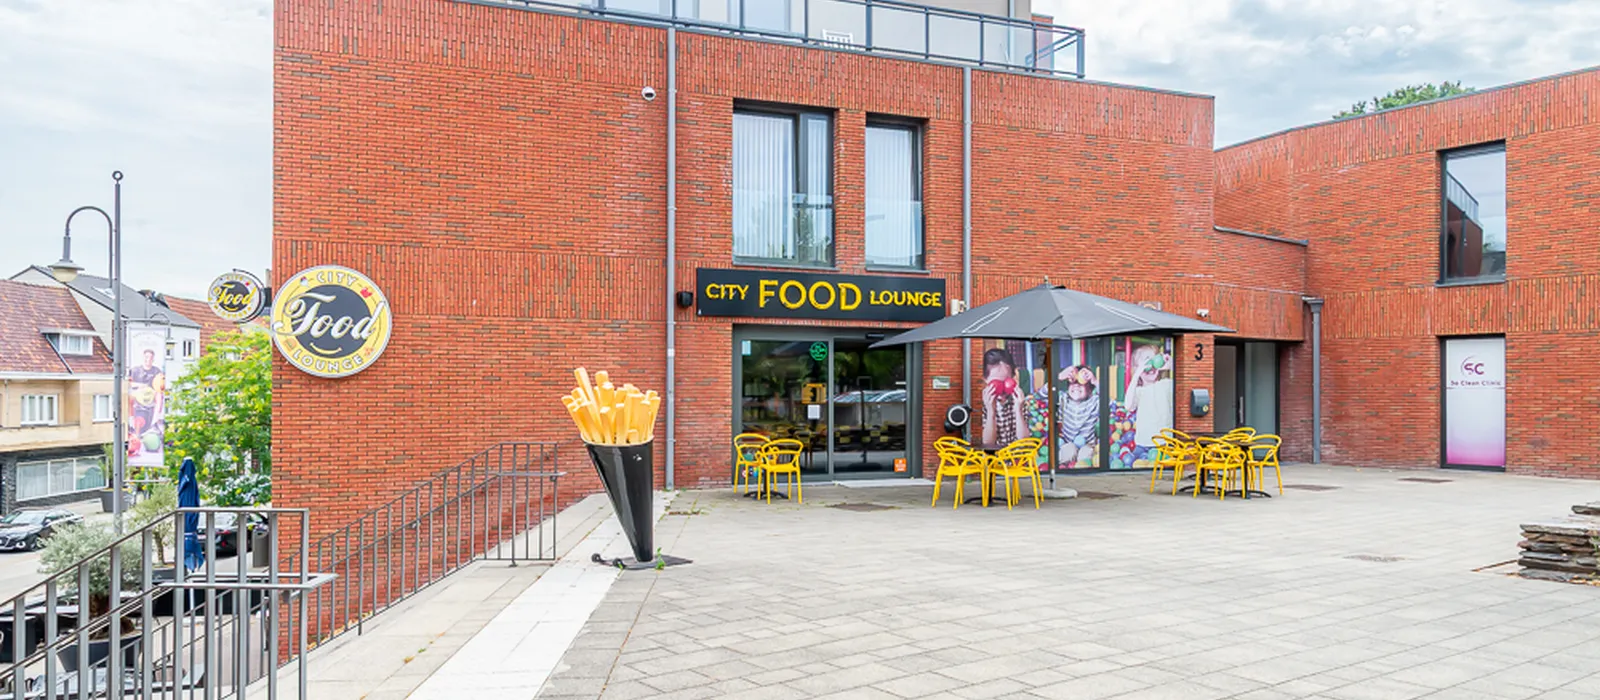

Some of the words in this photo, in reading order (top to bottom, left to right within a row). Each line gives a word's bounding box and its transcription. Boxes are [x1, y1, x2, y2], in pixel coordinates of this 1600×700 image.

[316, 271, 357, 286] CITY
[208, 283, 257, 305] Food
[705, 283, 749, 300] CITY
[759, 279, 862, 311] FOOD
[869, 290, 942, 307] LOUNGE
[272, 292, 386, 340] Food
[292, 349, 363, 373] LOUNGE
[1194, 342, 1203, 361] 3
